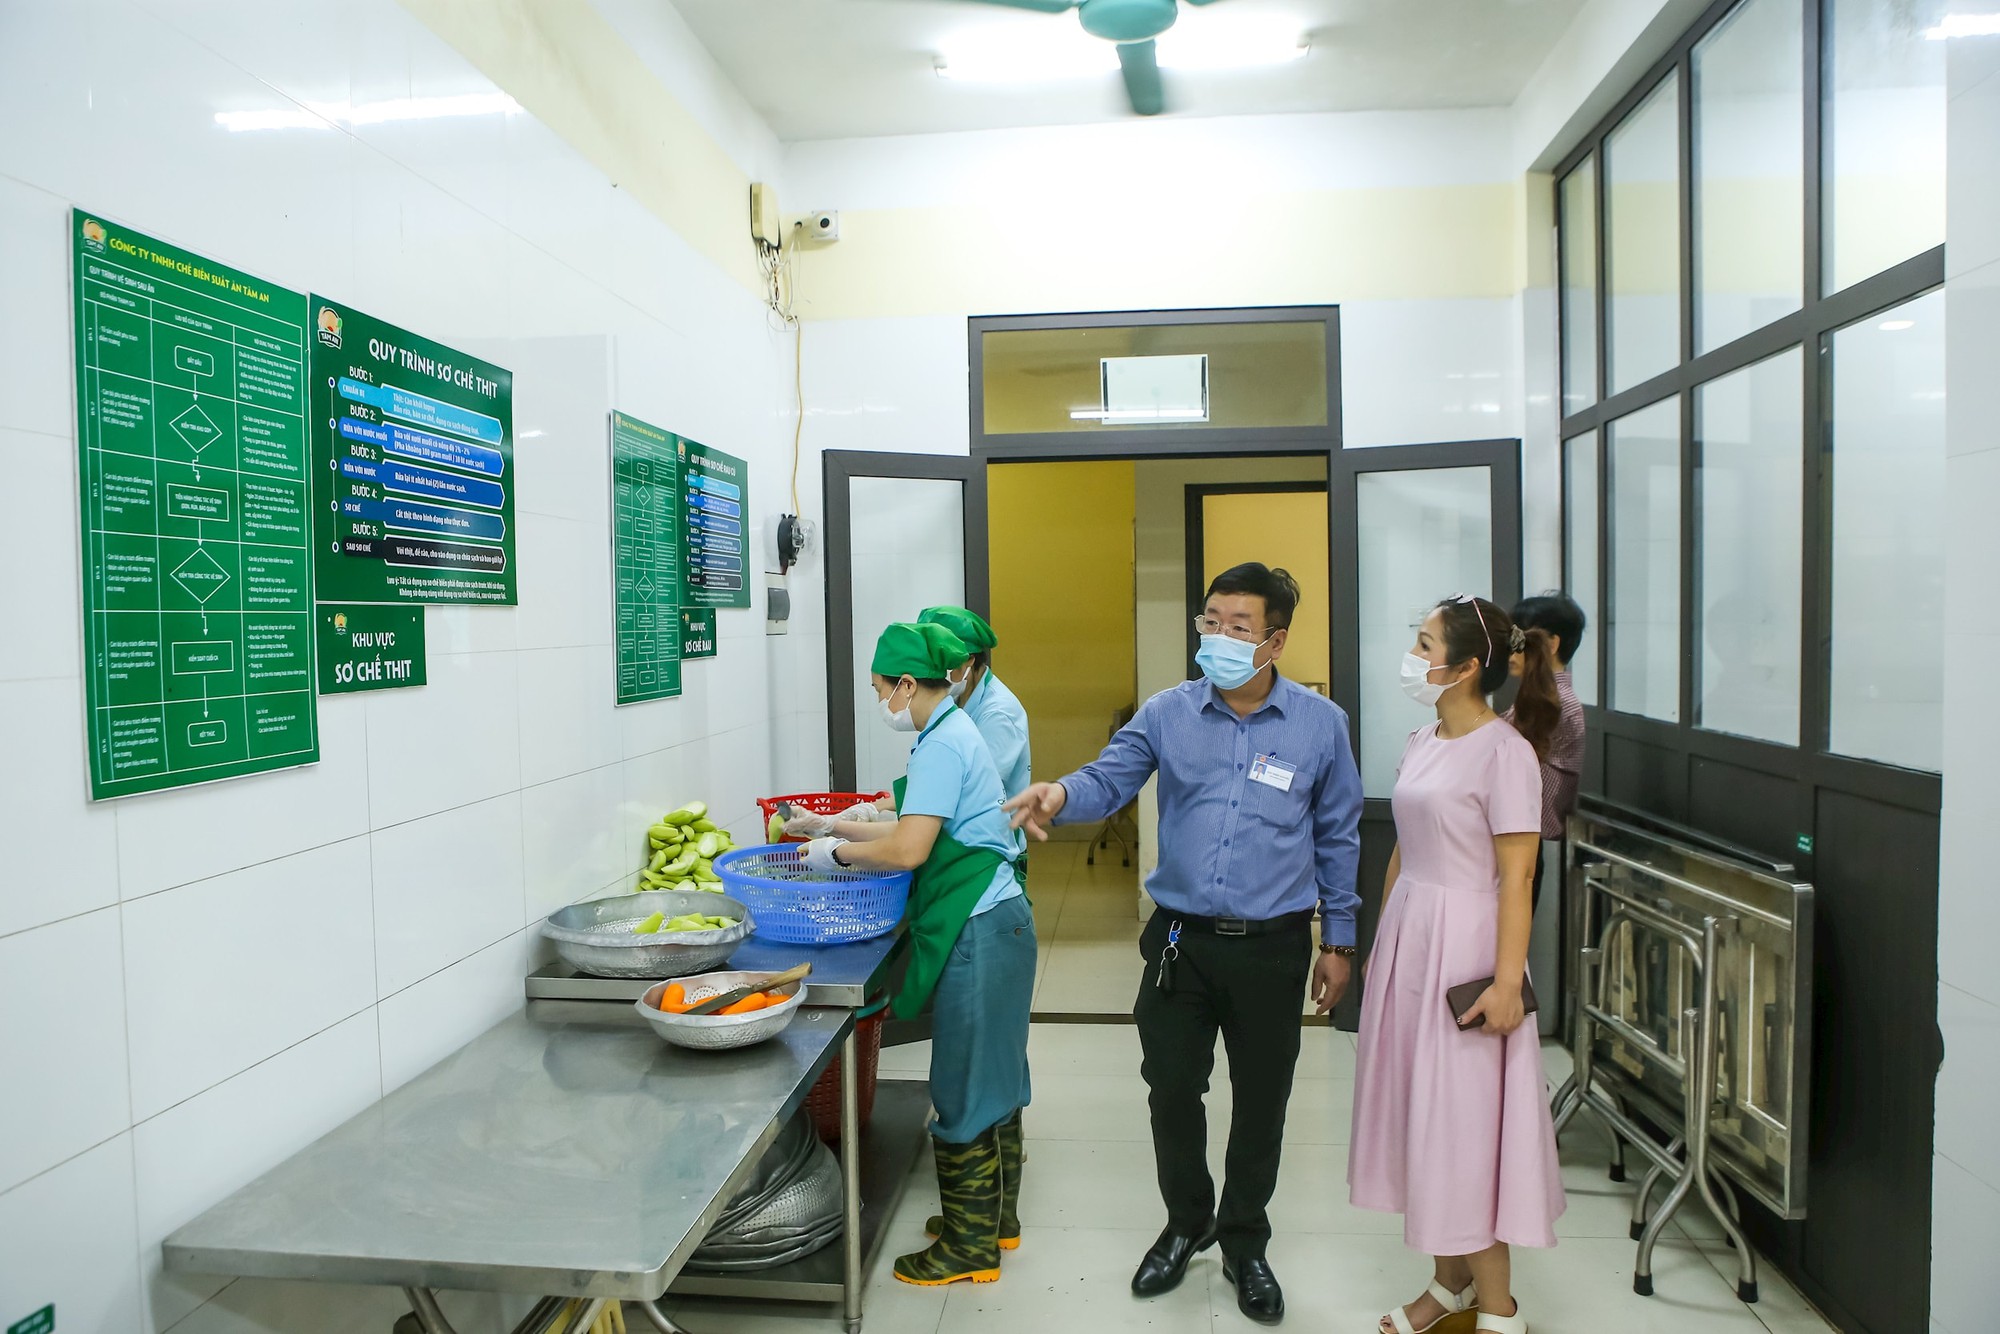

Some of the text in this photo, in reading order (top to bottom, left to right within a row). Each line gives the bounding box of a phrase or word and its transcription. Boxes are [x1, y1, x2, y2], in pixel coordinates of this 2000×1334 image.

[89, 265, 100, 274] QUY
[138, 247, 149, 259] TY
[150, 252, 174, 269] TNHH
[258, 292, 269, 302] AN
[349, 365, 373, 383] BƯỚC 1:
[368, 338, 497, 399] QUY TRÌNH SƠ CHẾ THỊT
[350, 404, 375, 420] BƯỚC 2:
[350, 444, 376, 460] BƯỚC 3:
[351, 483, 377, 498] BƯỚC 4:
[352, 521, 378, 536] BƯỚC 5:
[352, 632, 395, 649] KHU VỰC
[685, 636, 711, 653] SƠ CHẾ RAU
[335, 653, 411, 683] SƠ CHẾ THỊT
